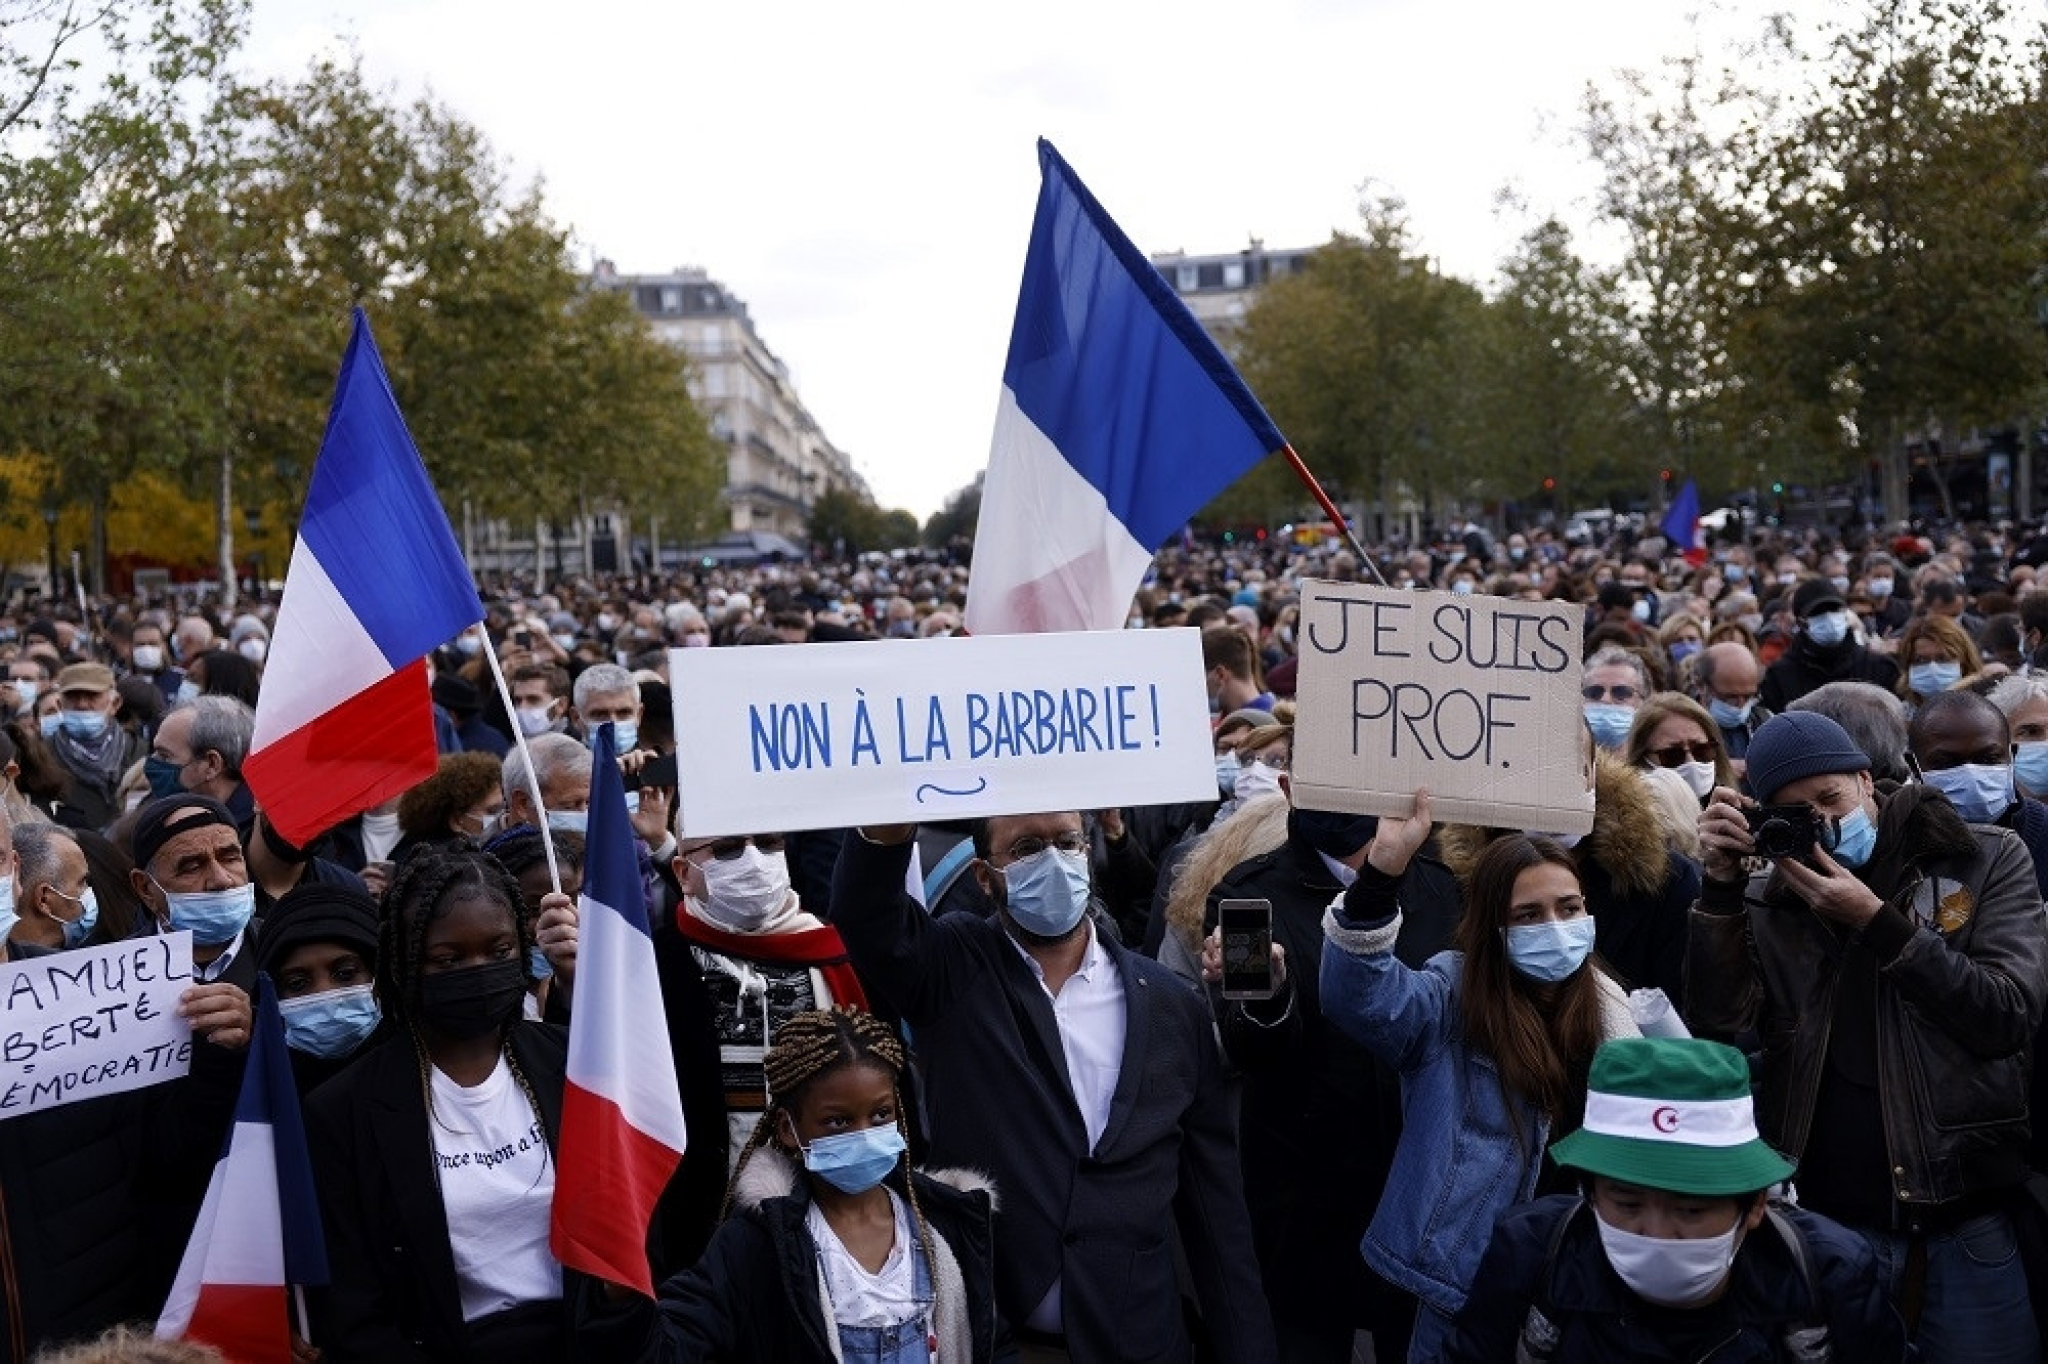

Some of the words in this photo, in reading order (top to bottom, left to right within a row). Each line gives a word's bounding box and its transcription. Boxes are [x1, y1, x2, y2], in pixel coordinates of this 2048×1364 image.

[1308, 595, 1412, 657] JE
[1428, 604, 1570, 672] SUIS
[749, 701, 832, 772] NON
[851, 687, 881, 766] À
[896, 695, 951, 763] LA
[1352, 677, 1531, 768] PROF.
[7, 939, 192, 1011] AMUEL
[3, 992, 160, 1062] BERTÉ
